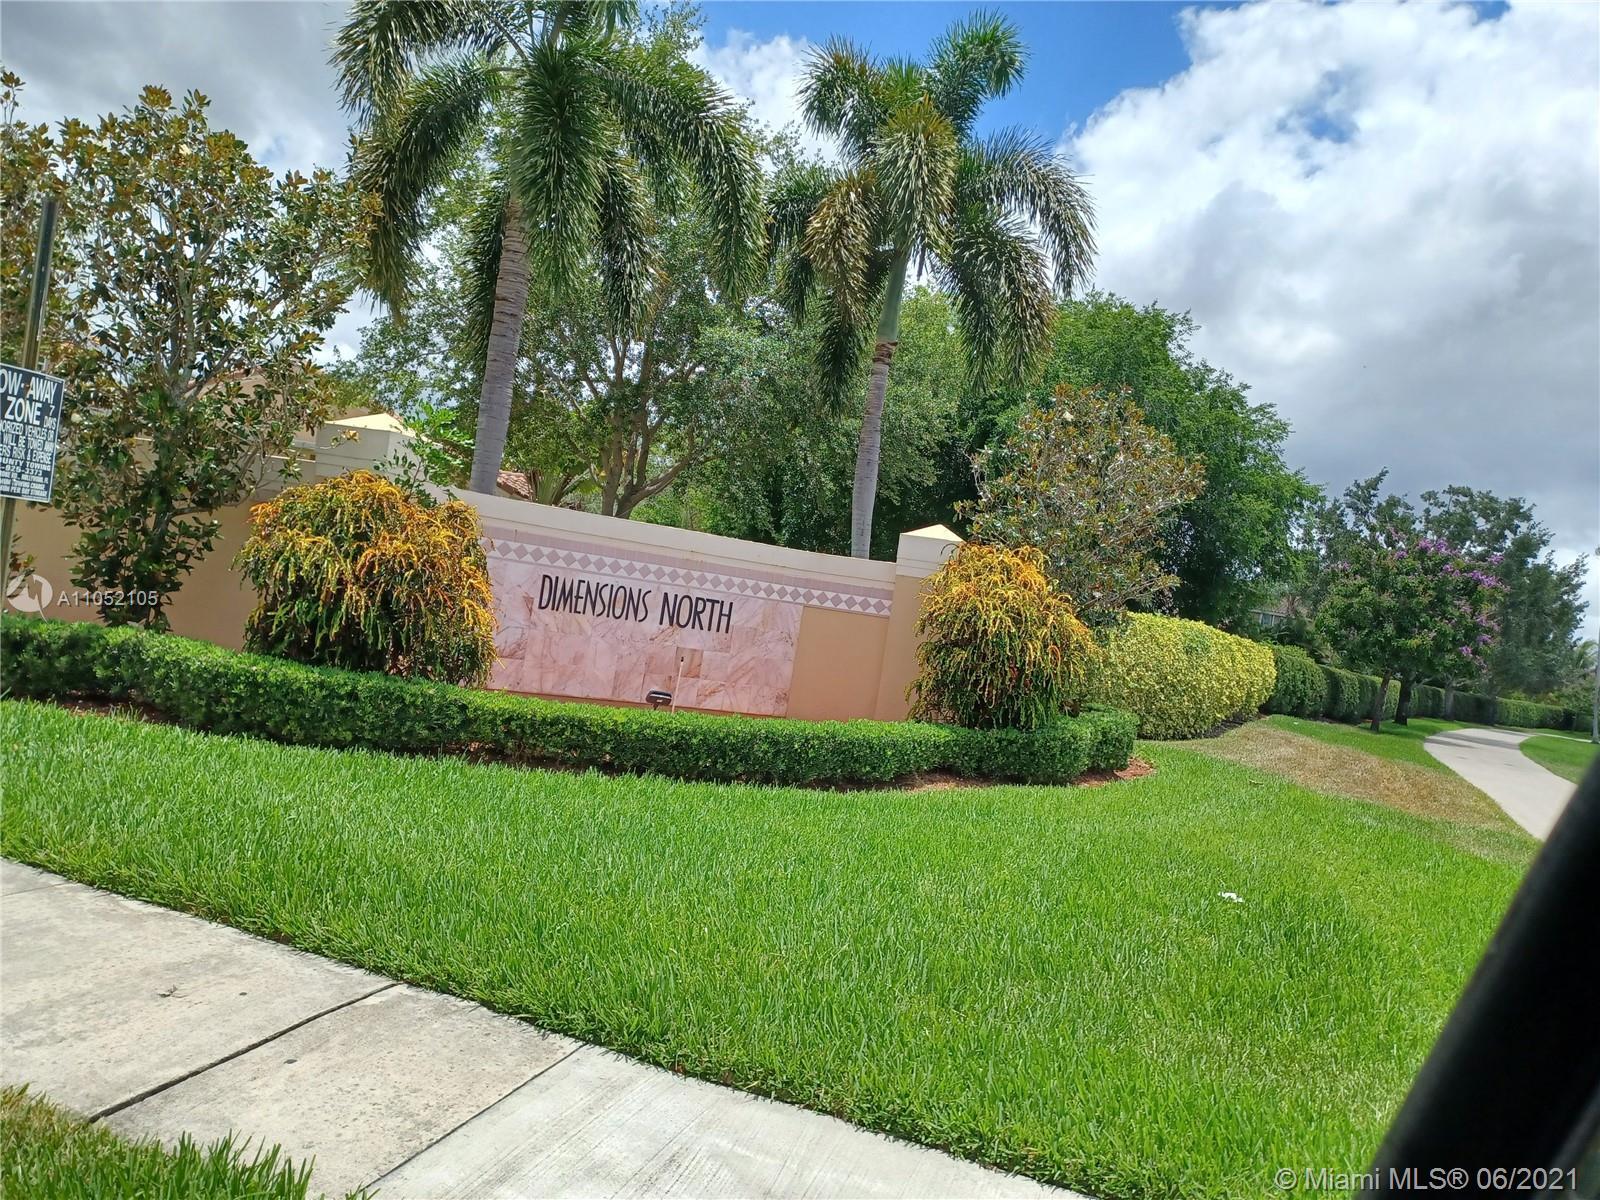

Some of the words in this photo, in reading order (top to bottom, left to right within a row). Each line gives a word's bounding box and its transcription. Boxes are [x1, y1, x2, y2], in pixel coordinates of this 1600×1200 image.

[5, 395, 42, 425] ZONE
[49, 404, 55, 416] 7
[25, 425, 47, 441] VEHICLES
[3, 434, 16, 446] WILL
[18, 435, 26, 448] BE
[12, 446, 26, 460] RISK
[26, 461, 51, 471] TOWING
[538, 574, 652, 623] DIMENSIONS
[659, 592, 734, 633] NORTH
